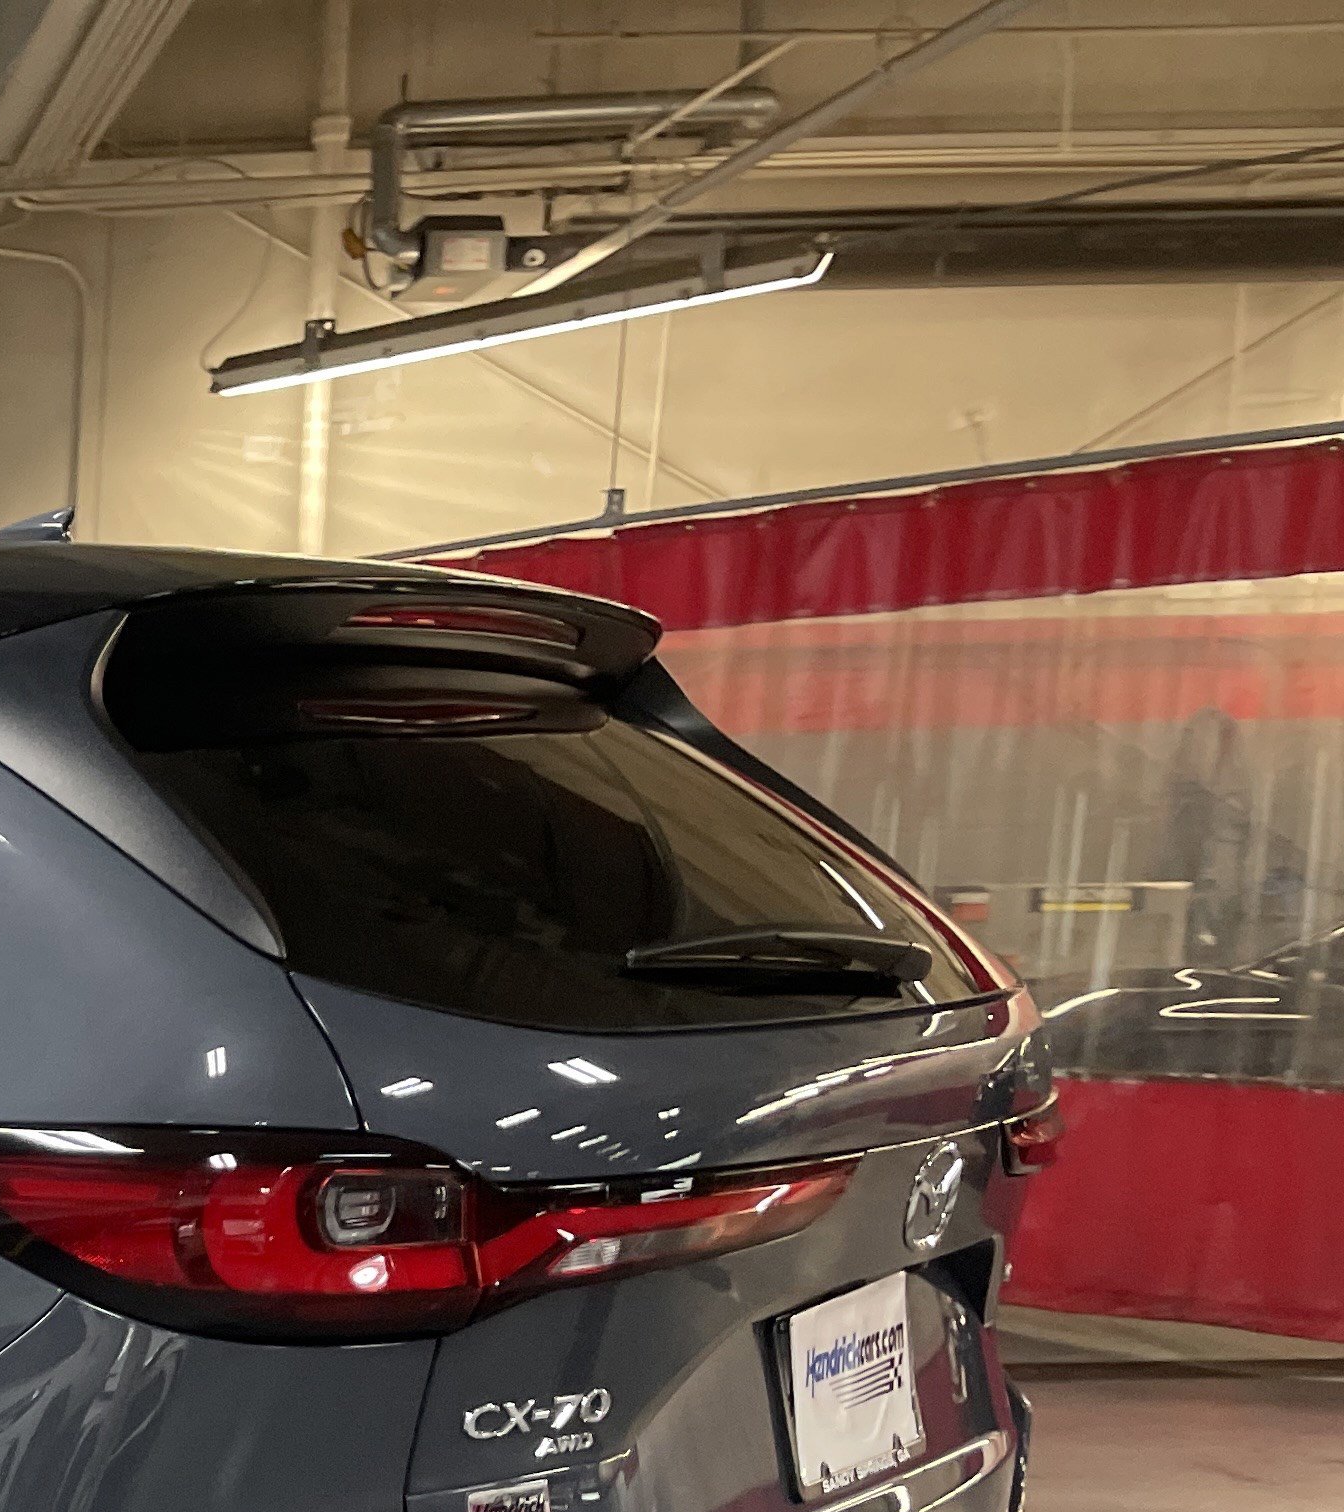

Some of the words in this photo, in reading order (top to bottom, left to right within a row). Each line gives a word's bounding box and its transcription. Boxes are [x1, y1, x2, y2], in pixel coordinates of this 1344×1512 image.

[806, 1322, 904, 1398] Hendrickcars.com
[464, 1388, 611, 1439] CX-70
[534, 1432, 594, 1458] AWD
